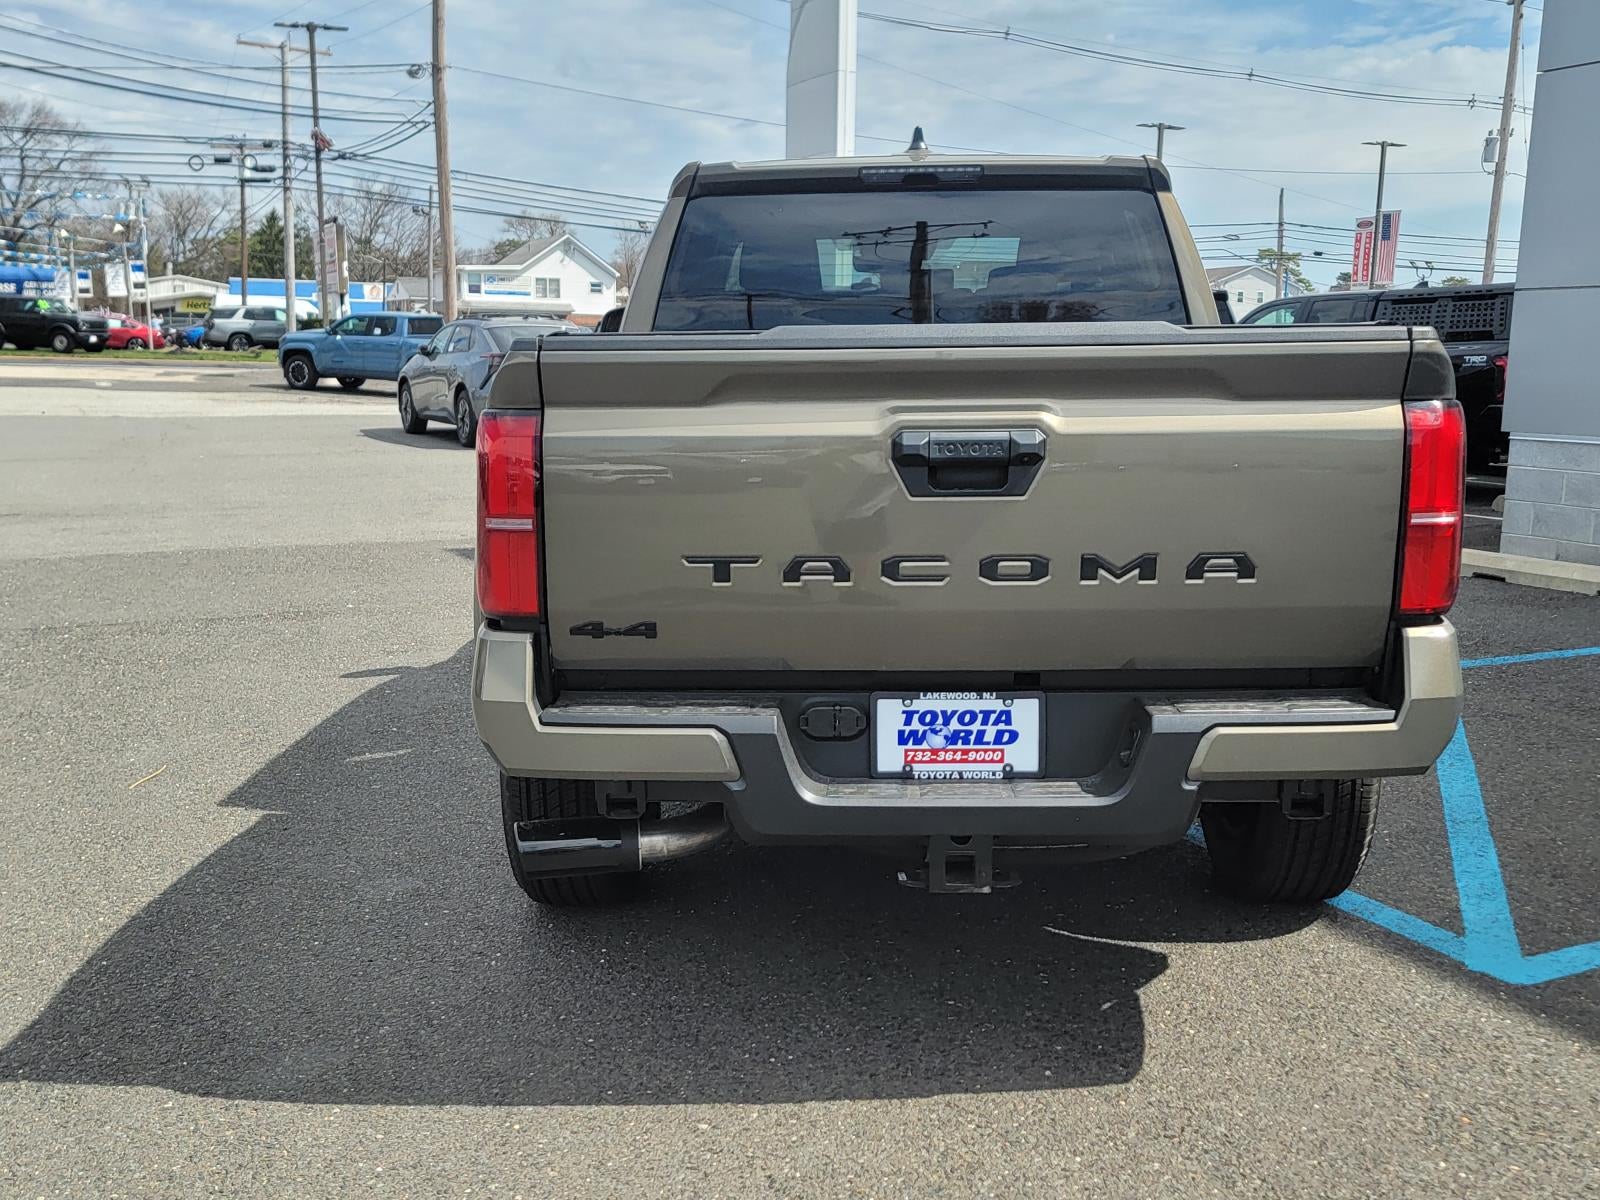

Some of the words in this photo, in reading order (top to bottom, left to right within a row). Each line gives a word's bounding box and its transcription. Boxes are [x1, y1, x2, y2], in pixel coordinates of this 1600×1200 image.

[1352, 233, 1361, 282] TOYOTA
[932, 442, 1005, 456] TOYOTA
[681, 552, 1258, 587] TACOMA
[982, 692, 996, 700] NJ
[901, 709, 1013, 727] TOYOTA
[897, 728, 1019, 747] WORLD
[906, 751, 1002, 761] 732-364-9000
[912, 771, 960, 779] TOYOTA
[962, 771, 1004, 779] WORLD
